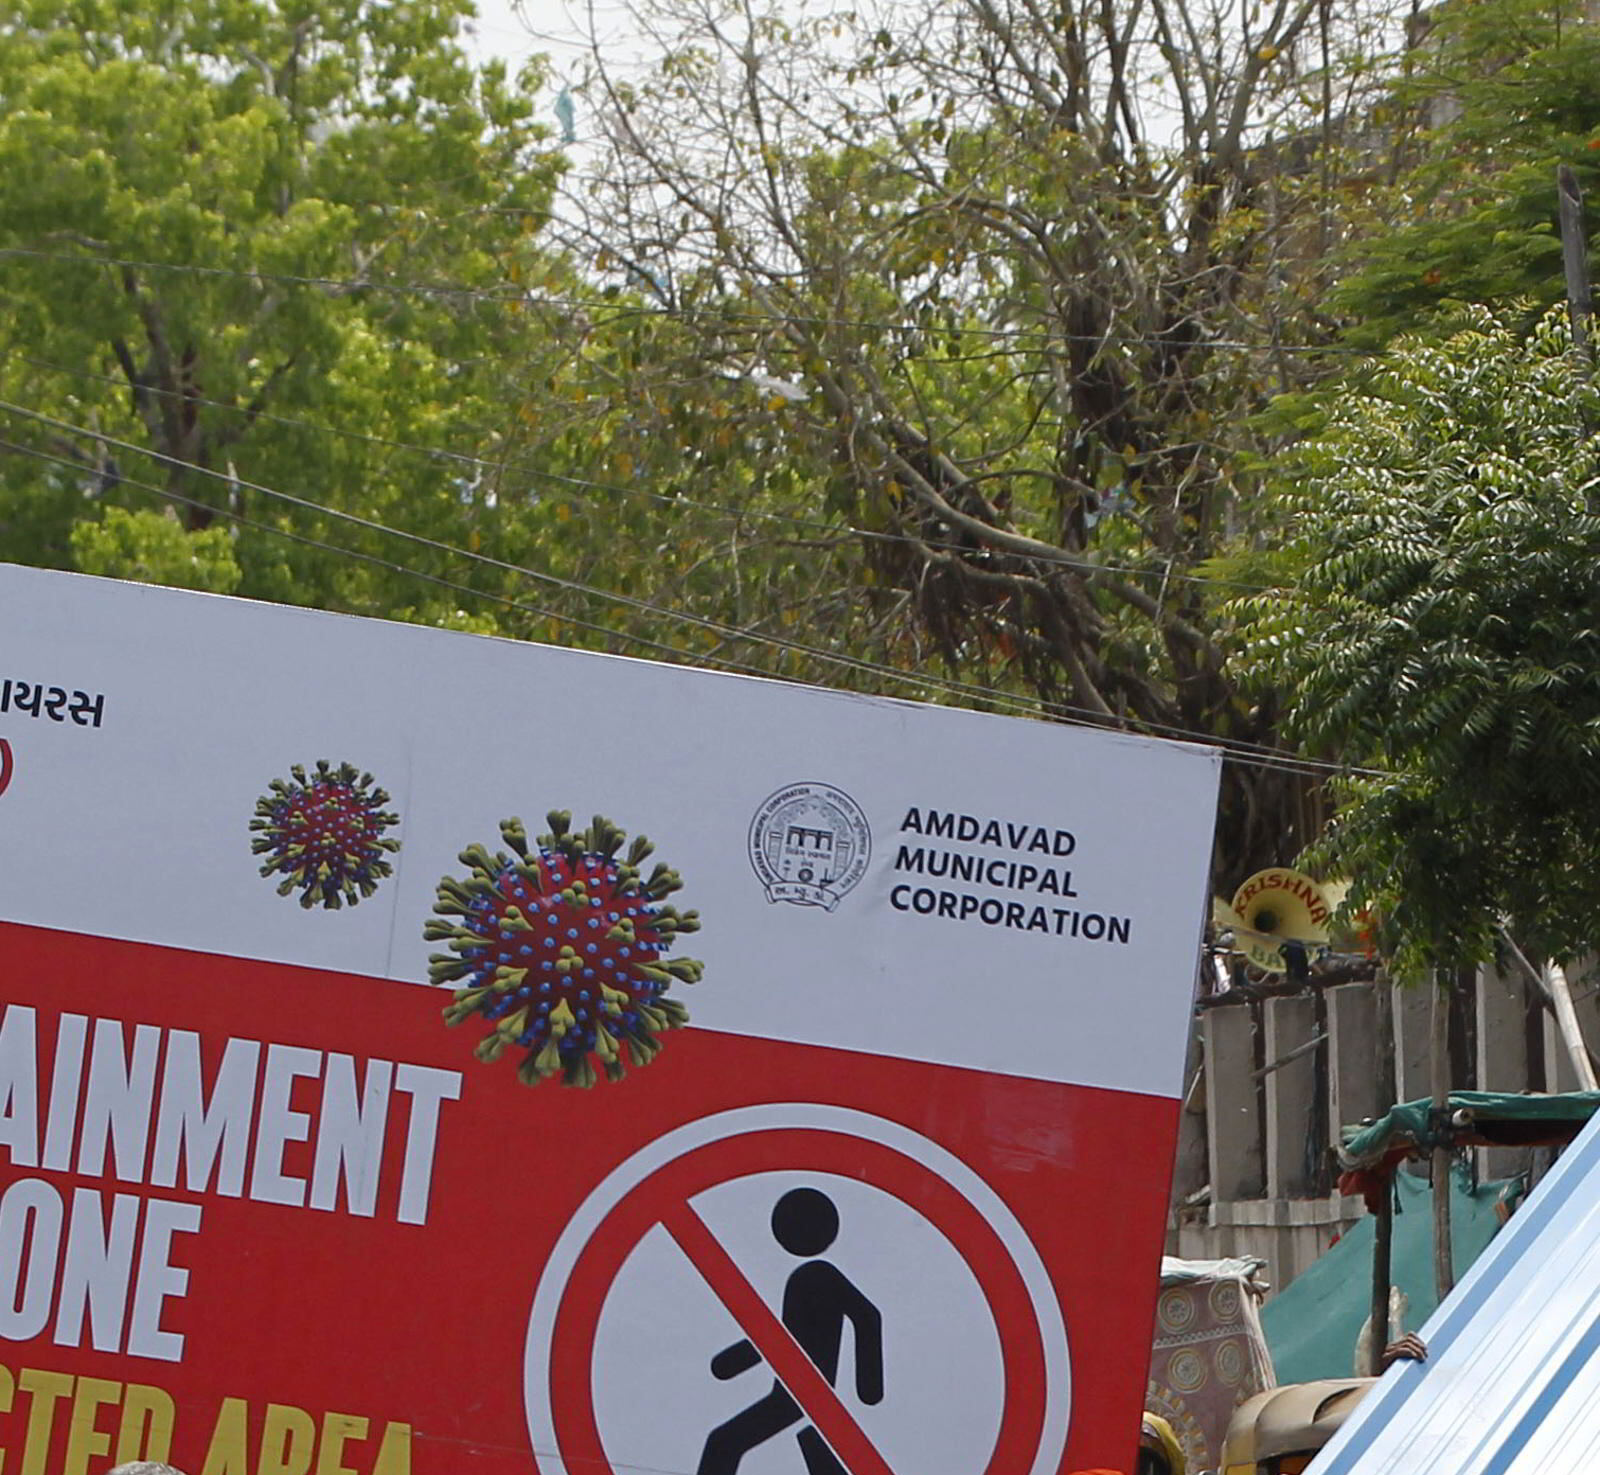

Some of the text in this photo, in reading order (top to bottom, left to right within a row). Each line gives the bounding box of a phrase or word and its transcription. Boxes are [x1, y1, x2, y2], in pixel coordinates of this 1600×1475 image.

[900, 807, 1076, 857] AMDAVAD
[894, 846, 1077, 898] MUNICIPAL
[889, 885, 1131, 943] CORPORATION
[1234, 874, 1327, 925] KRISHNA
